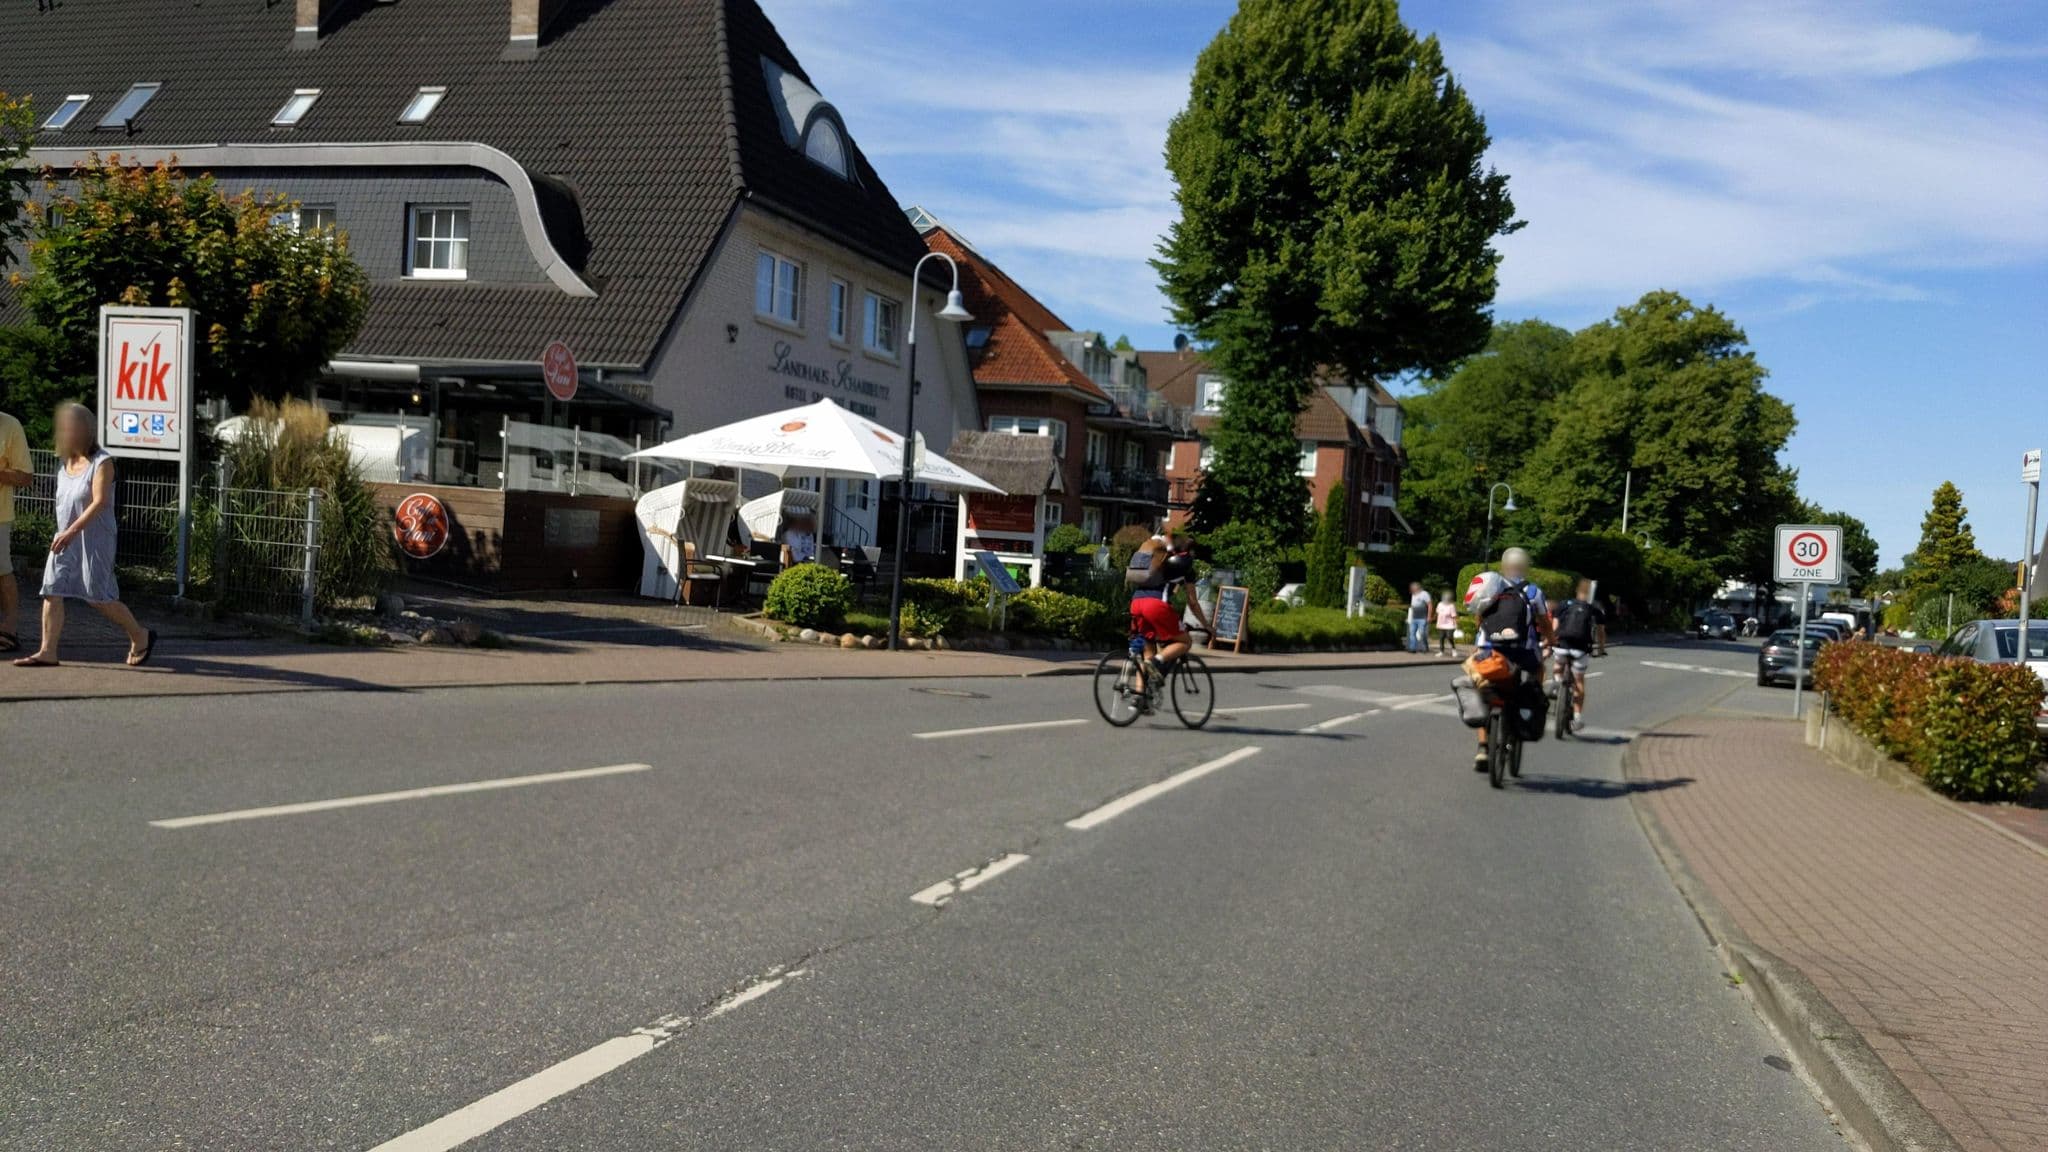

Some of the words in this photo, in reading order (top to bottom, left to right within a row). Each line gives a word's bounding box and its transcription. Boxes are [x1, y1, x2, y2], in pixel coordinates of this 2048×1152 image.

[116, 341, 172, 401] kik
[1797, 542, 1819, 557] 30
[1792, 568, 1822, 577] ZONE
